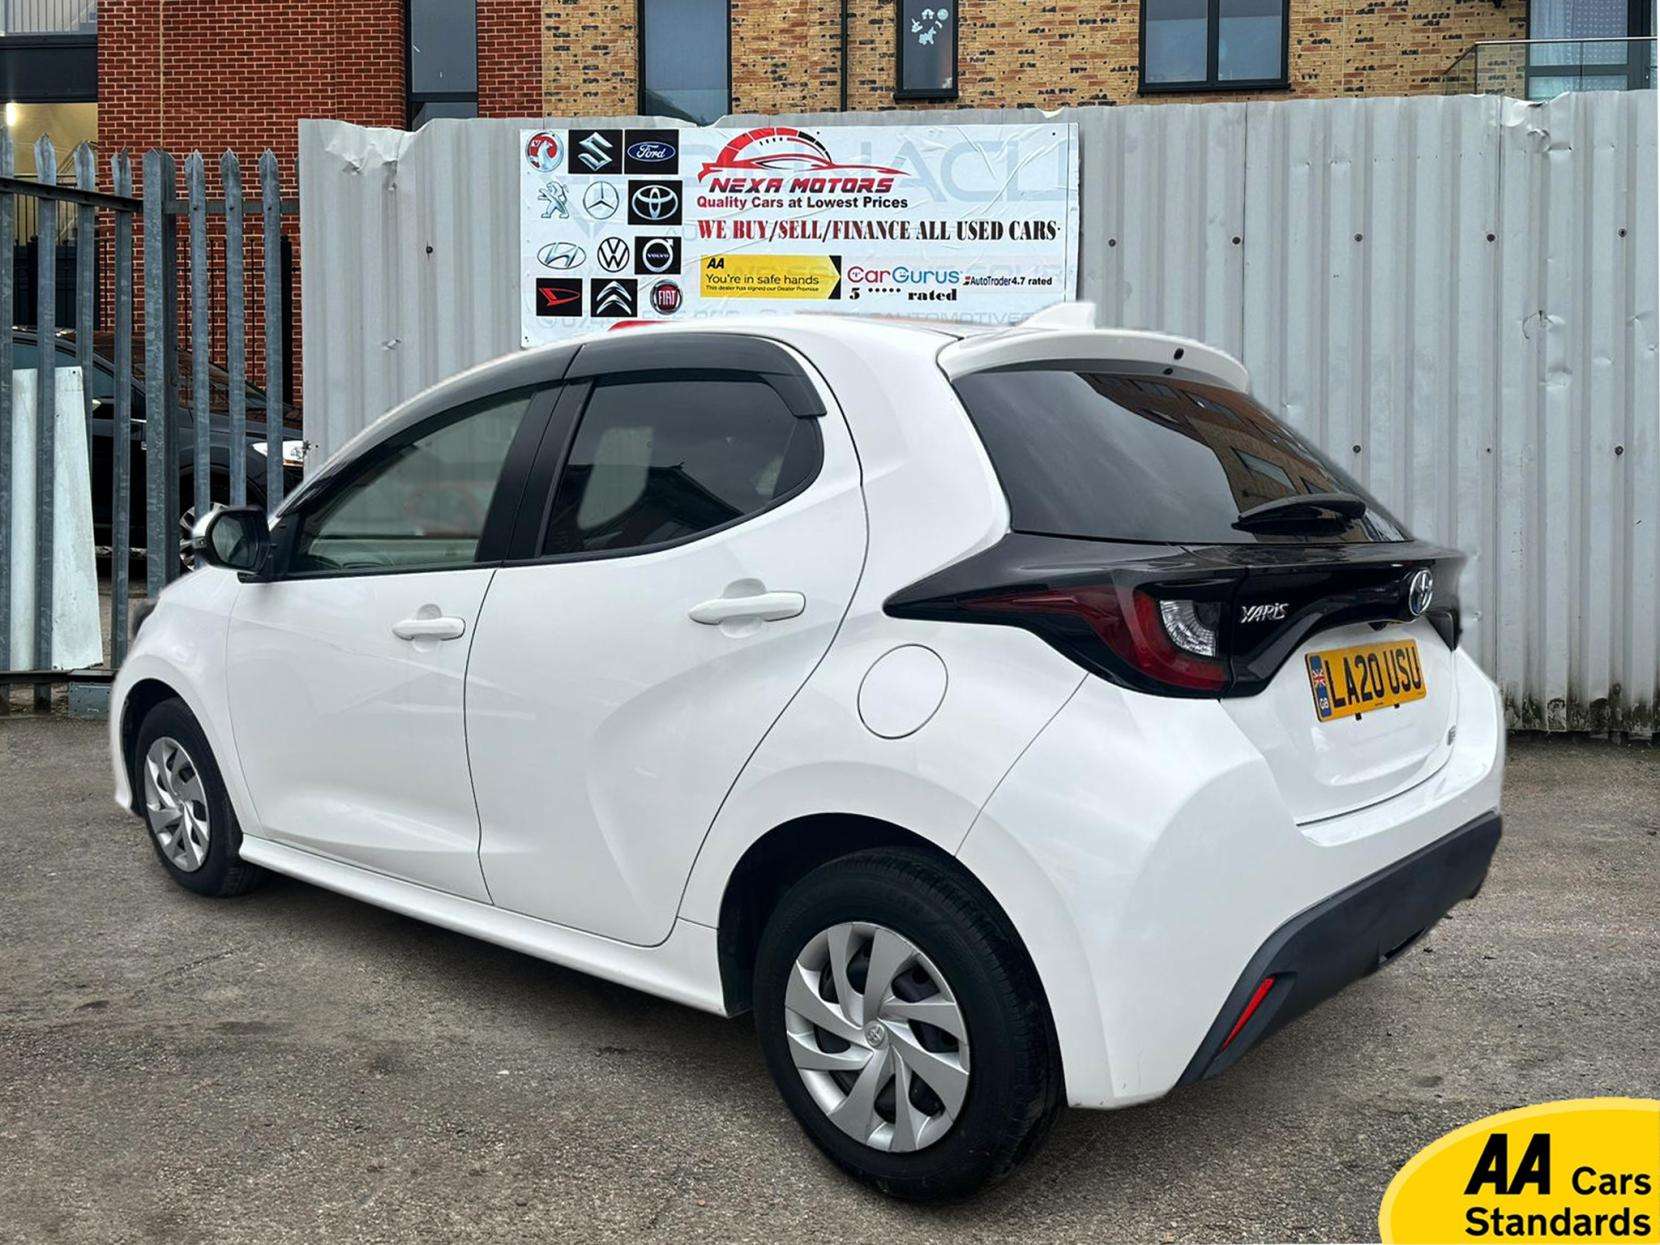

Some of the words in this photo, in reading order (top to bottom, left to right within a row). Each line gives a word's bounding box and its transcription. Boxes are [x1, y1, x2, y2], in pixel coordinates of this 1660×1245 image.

[636, 144, 667, 159] Ford
[709, 177, 783, 193] NEXA
[789, 177, 895, 193] MOTORS
[697, 196, 748, 210] Quality
[751, 197, 784, 208] Cars
[788, 197, 803, 208] at
[807, 197, 859, 208] Lowest
[863, 196, 908, 208] Prices
[698, 220, 726, 239] WE
[916, 220, 951, 240] ALL
[956, 220, 1004, 240] USED
[1008, 220, 1056, 240] CARS
[707, 257, 725, 269] AA
[706, 274, 741, 284] You're
[744, 274, 754, 284] in
[757, 274, 781, 285] safe
[784, 275, 819, 285] hands
[847, 266, 960, 284] CarGurus
[1028, 277, 1053, 286] rated
[658, 290, 676, 306] FIAT
[849, 287, 860, 300] 5
[908, 288, 957, 301] rated
[1325, 653, 1385, 708] LA20
[1383, 646, 1422, 694] USU
